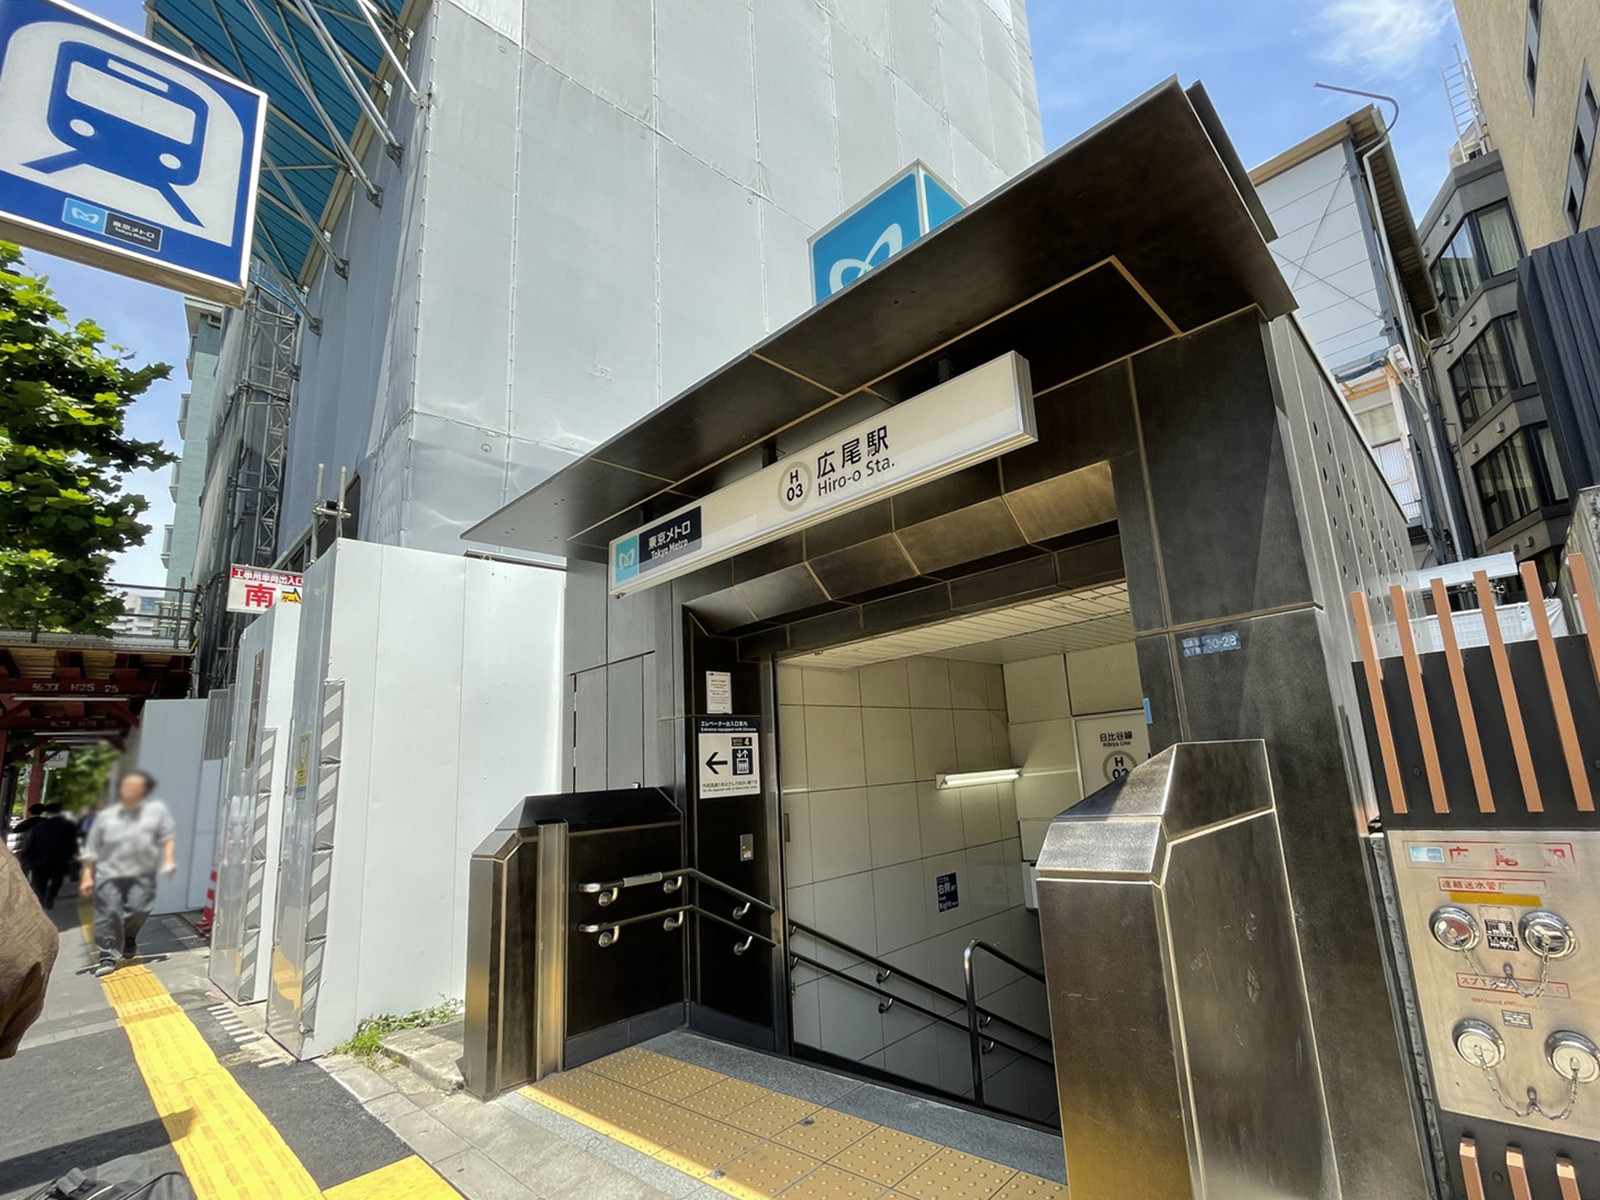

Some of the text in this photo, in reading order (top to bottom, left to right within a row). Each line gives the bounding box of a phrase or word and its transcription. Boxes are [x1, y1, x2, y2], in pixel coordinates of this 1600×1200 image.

[112, 220, 155, 239] 東京メトロ
[816, 425, 889, 479] 広尾駅
[790, 469, 799, 484] H
[818, 457, 895, 497] Hiro-o Sta.
[786, 483, 804, 502] 03
[648, 520, 690, 550] 東京メトロ
[651, 538, 689, 560] Tokyo Metro
[244, 583, 276, 608] 南
[1100, 731, 1133, 742] 日比谷線
[1114, 756, 1124, 767] H
